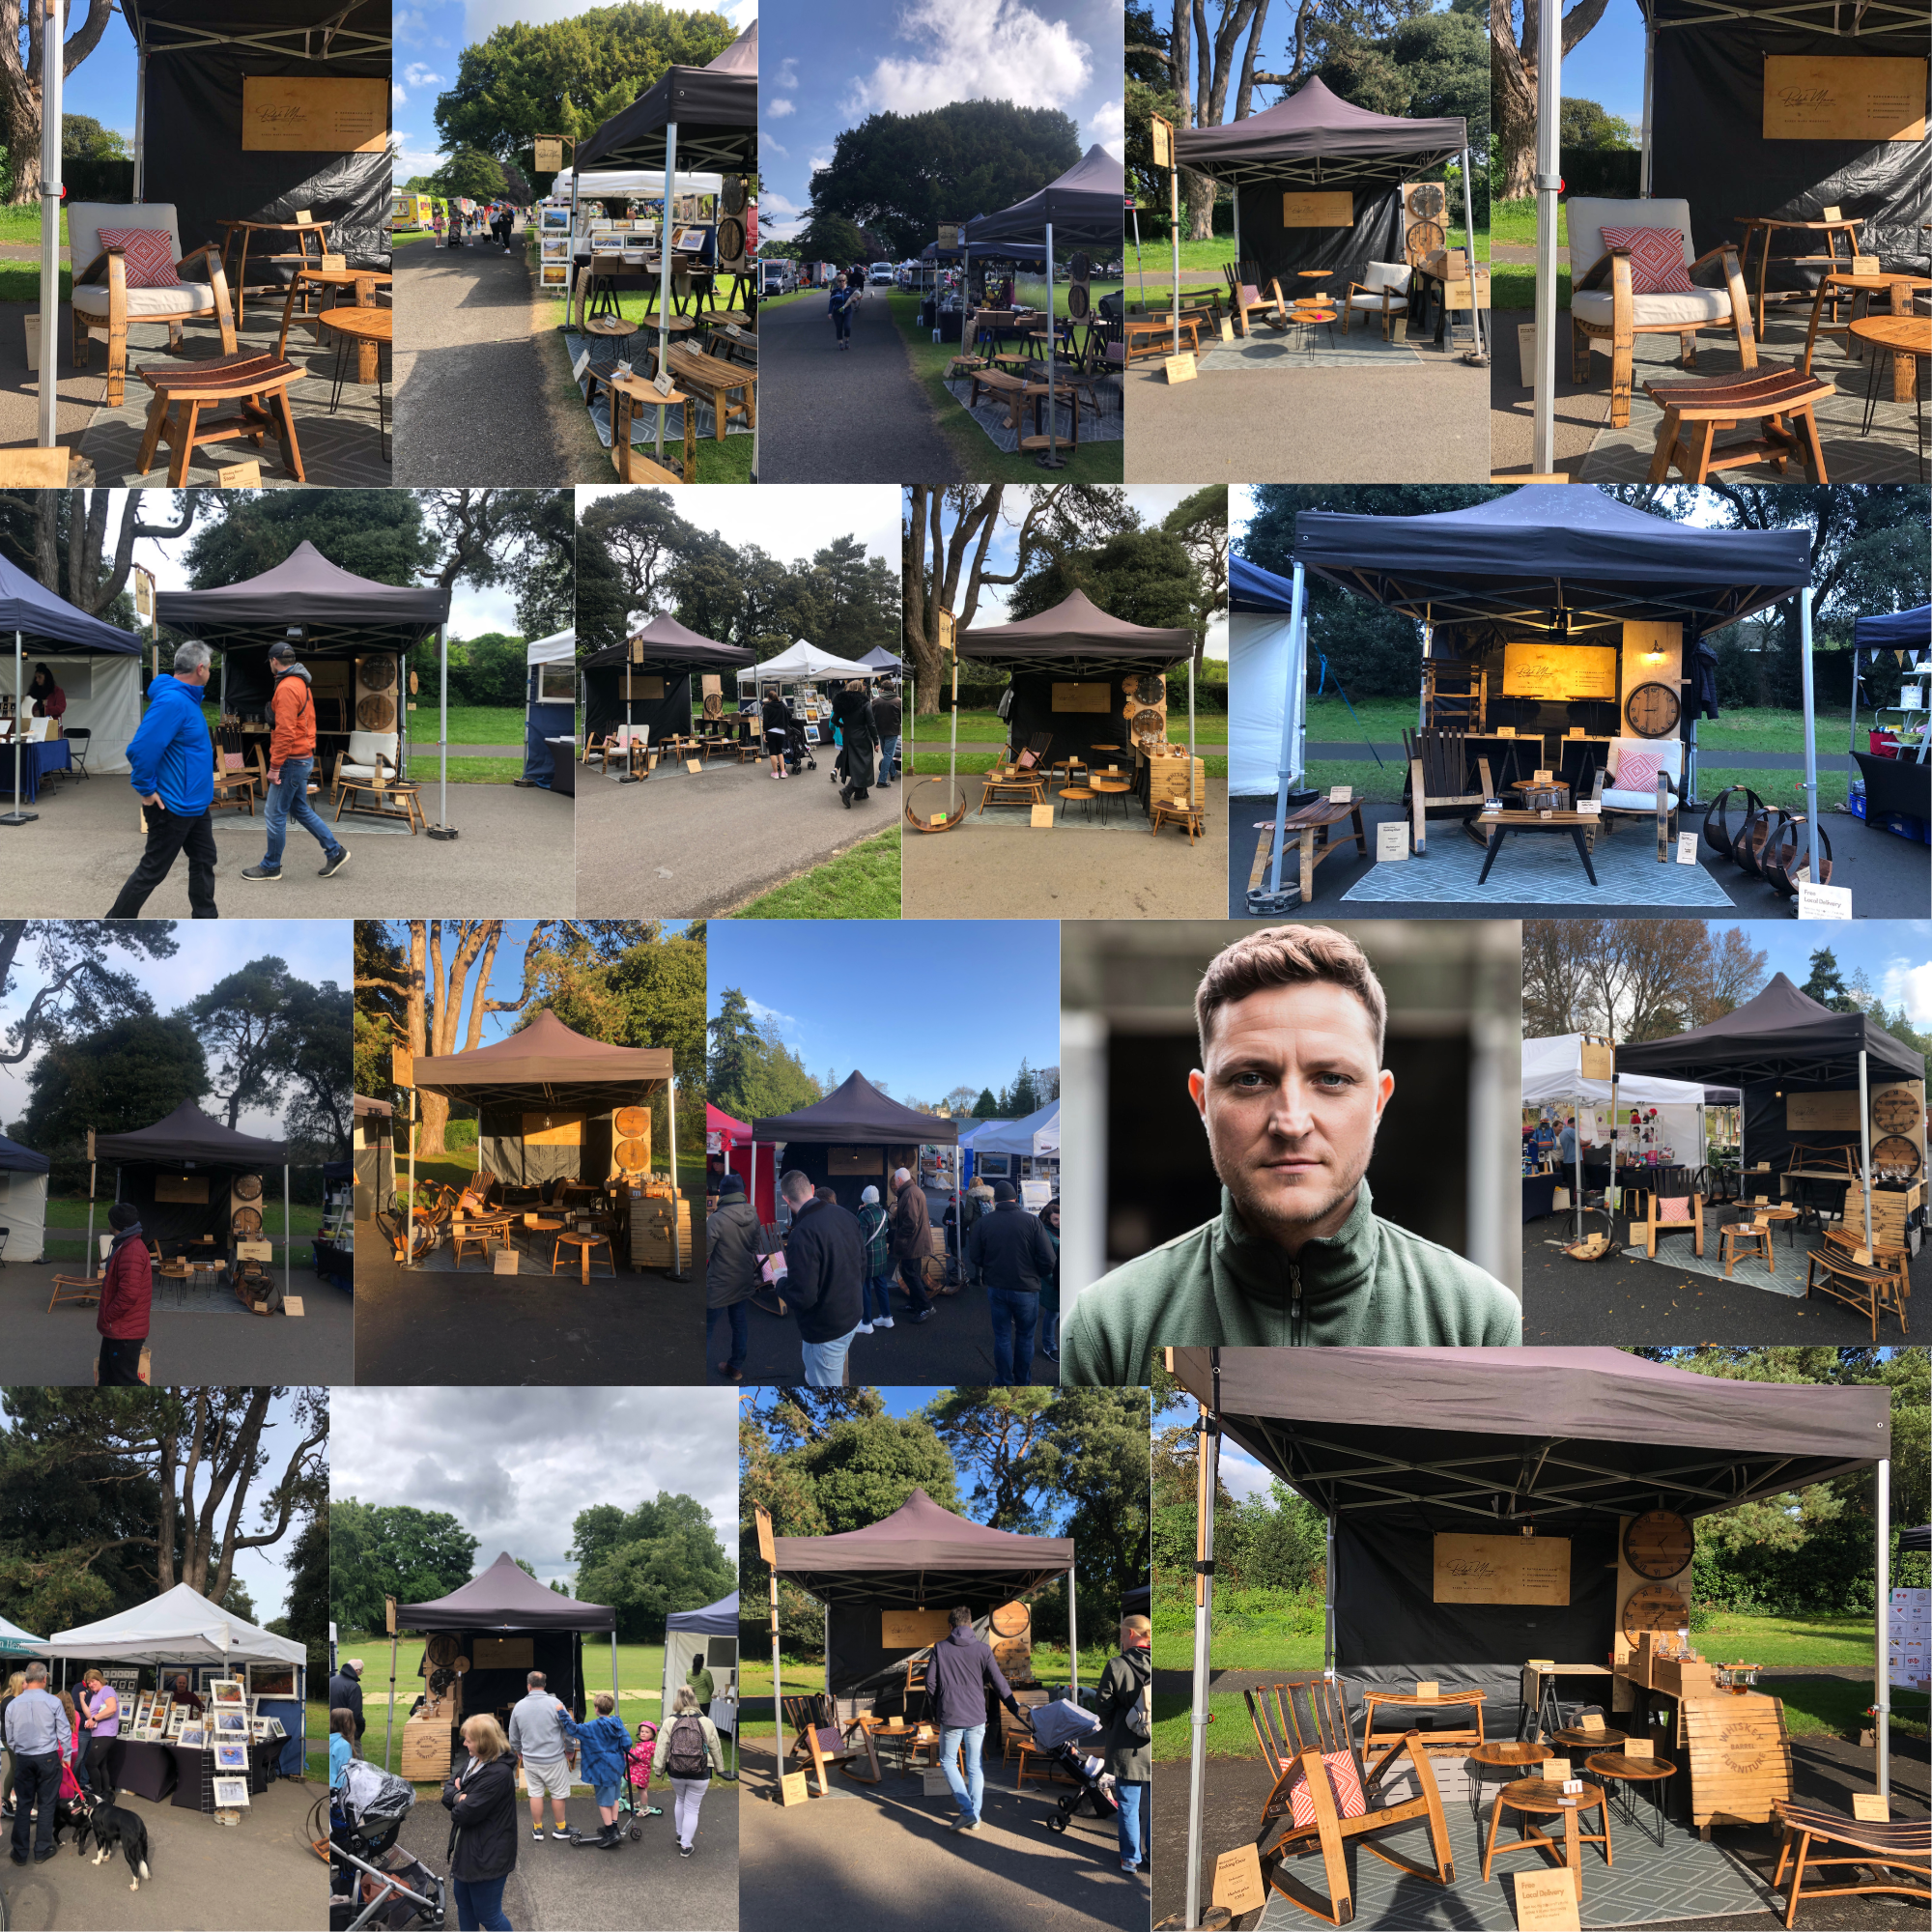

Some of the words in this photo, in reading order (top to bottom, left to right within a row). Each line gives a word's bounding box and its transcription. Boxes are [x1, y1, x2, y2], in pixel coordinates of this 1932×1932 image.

[1819, 898, 1841, 908] Delivery
[1719, 1722, 1764, 1743] WHISKEY
[1720, 1751, 1766, 1774] FURNITURE
[1522, 1890, 1539, 1899] Local
